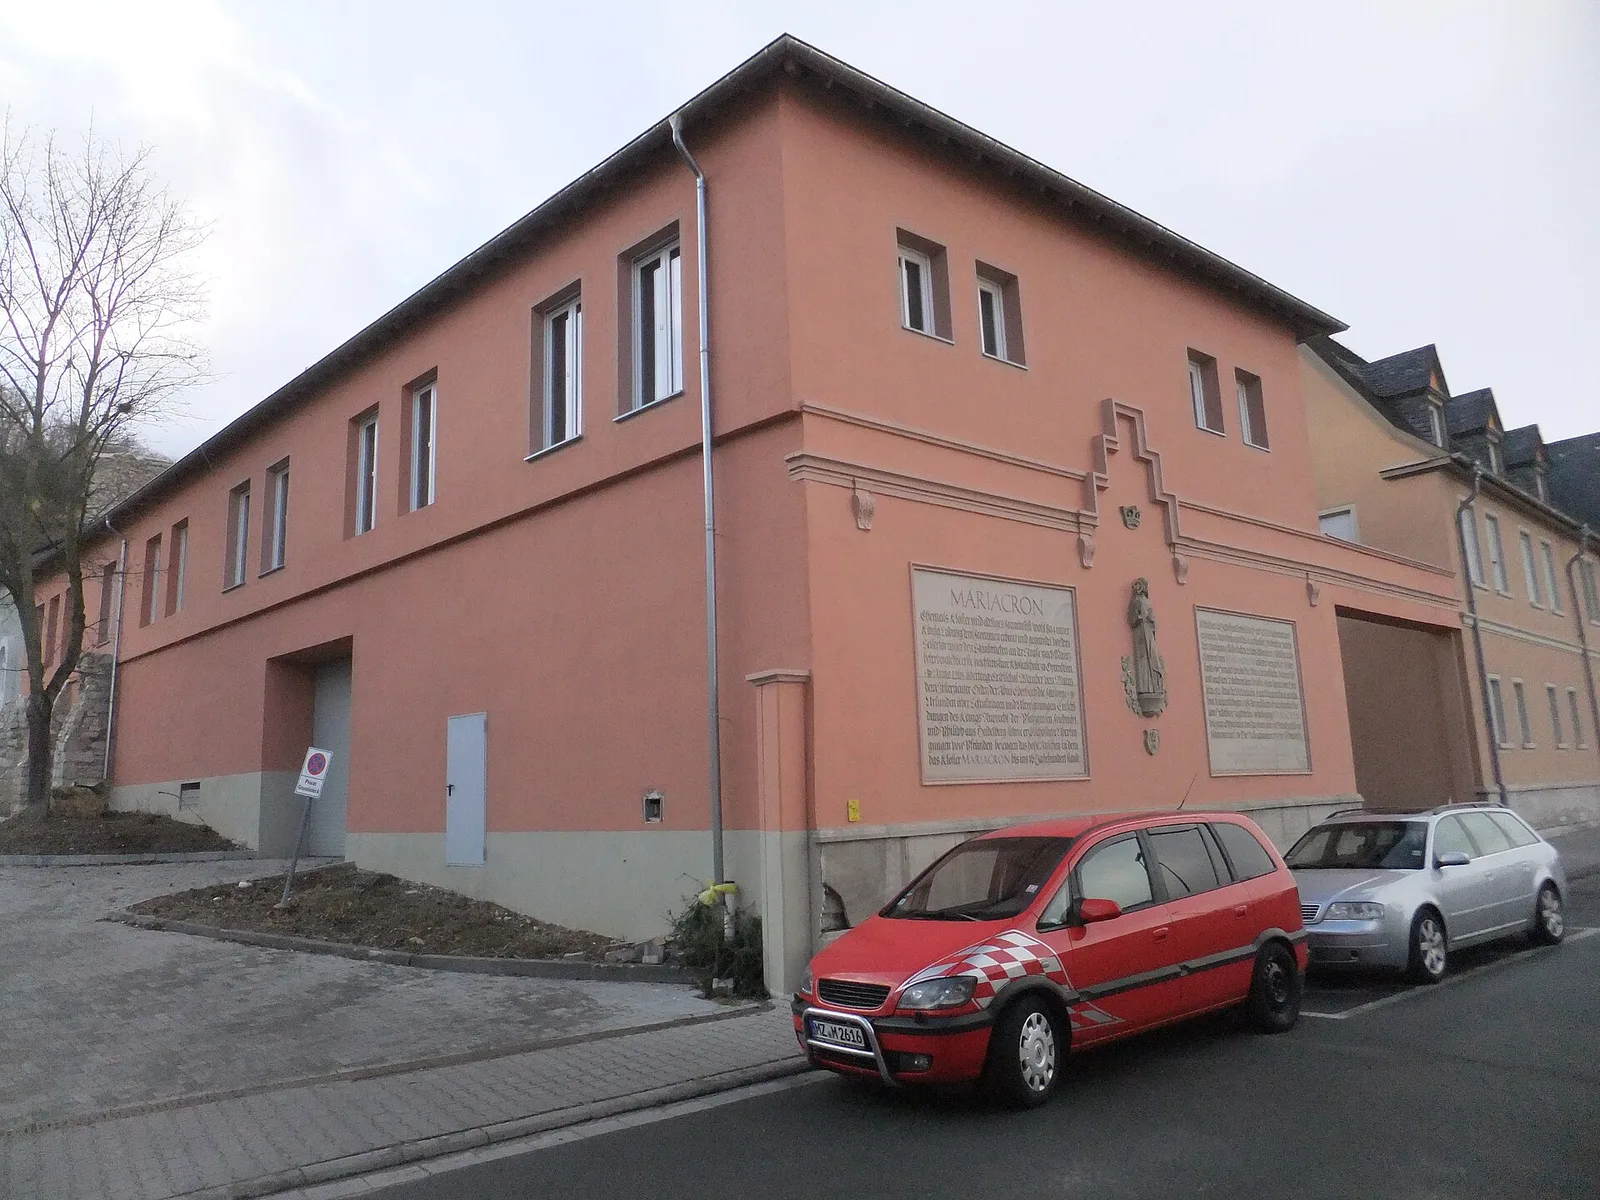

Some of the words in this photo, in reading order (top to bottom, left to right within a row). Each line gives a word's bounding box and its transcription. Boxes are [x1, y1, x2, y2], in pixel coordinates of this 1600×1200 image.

[950, 587, 1044, 616] MARIACRON
[962, 755, 1010, 765] MARIACRON
[814, 1023, 828, 1037] MZ
